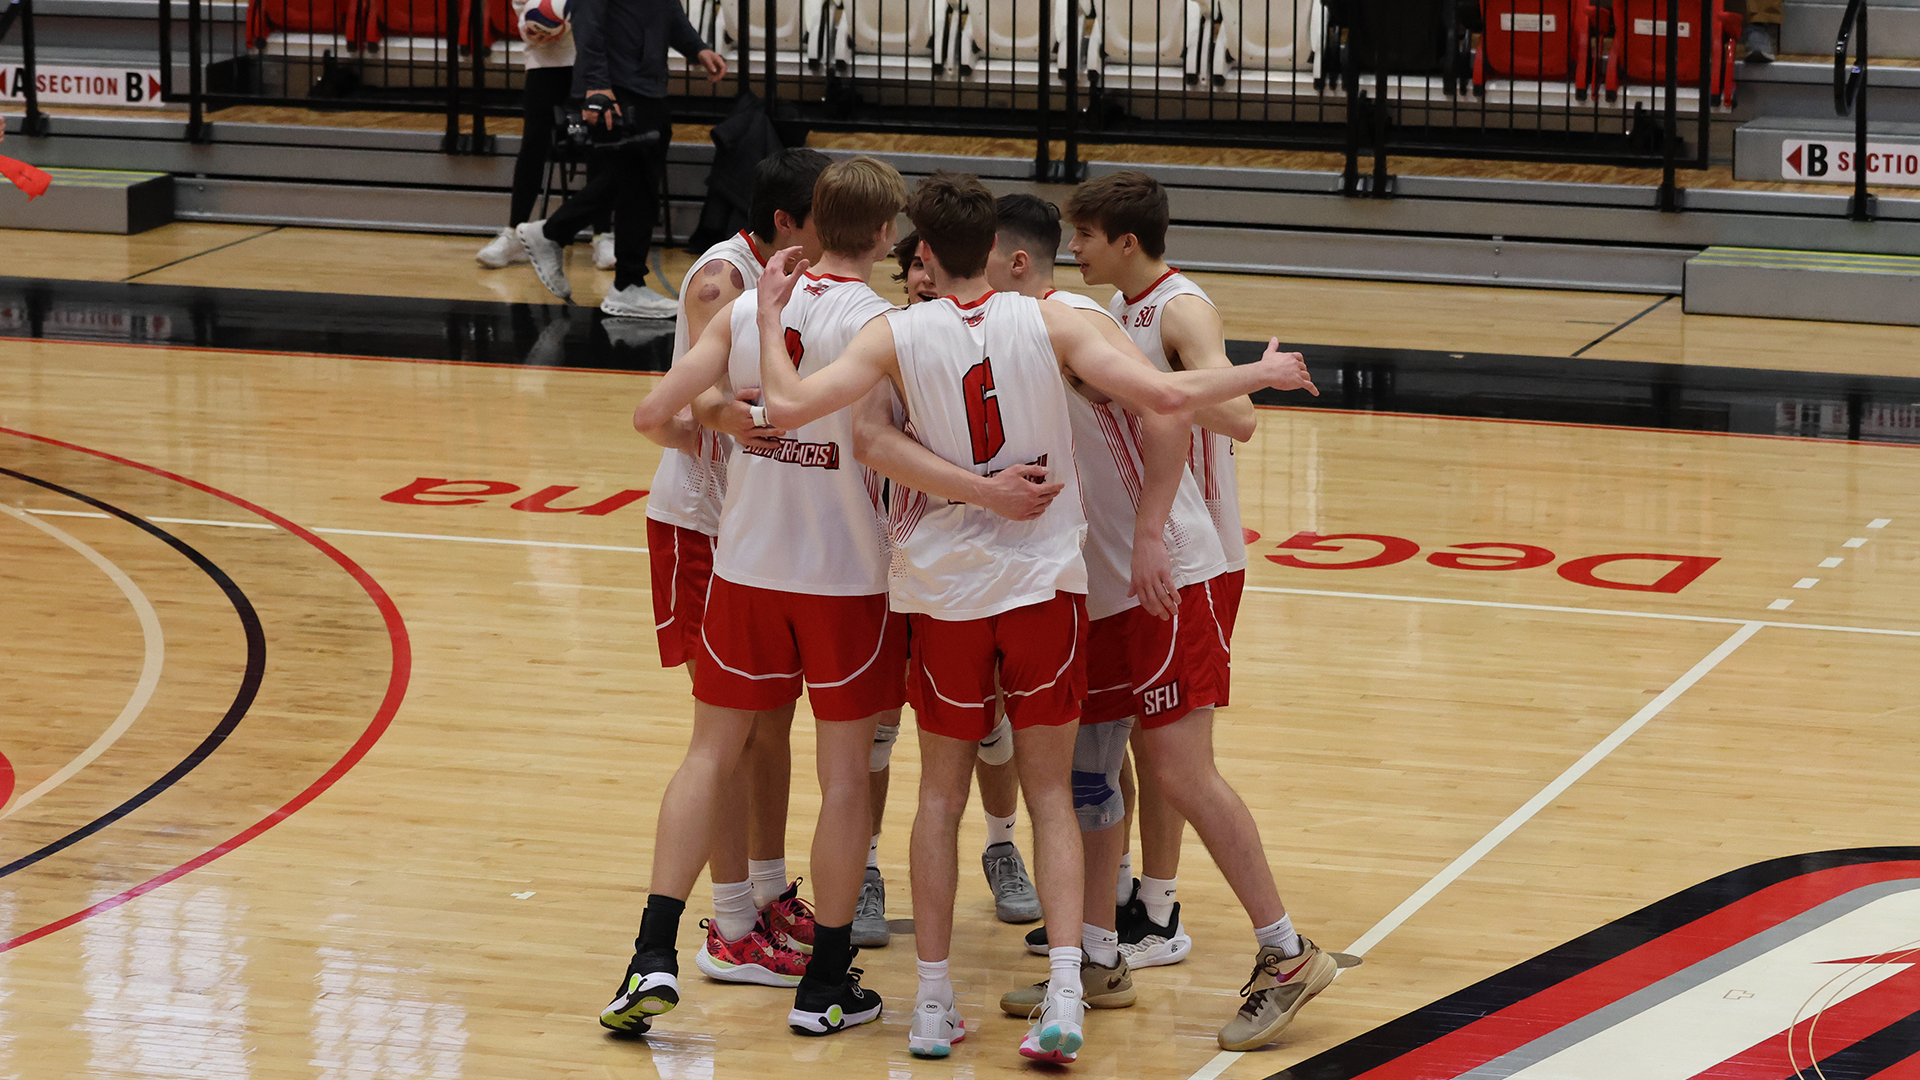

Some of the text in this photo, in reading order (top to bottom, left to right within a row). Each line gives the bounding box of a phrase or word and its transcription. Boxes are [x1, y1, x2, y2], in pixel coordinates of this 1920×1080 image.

[36, 74, 118, 96] SECTION
[126, 72, 144, 102] B
[1807, 143, 1918, 177] B SCTIO
[962, 356, 1006, 465] 6
[1244, 527, 1722, 594] DeG
[1143, 680, 1180, 717] SFU
